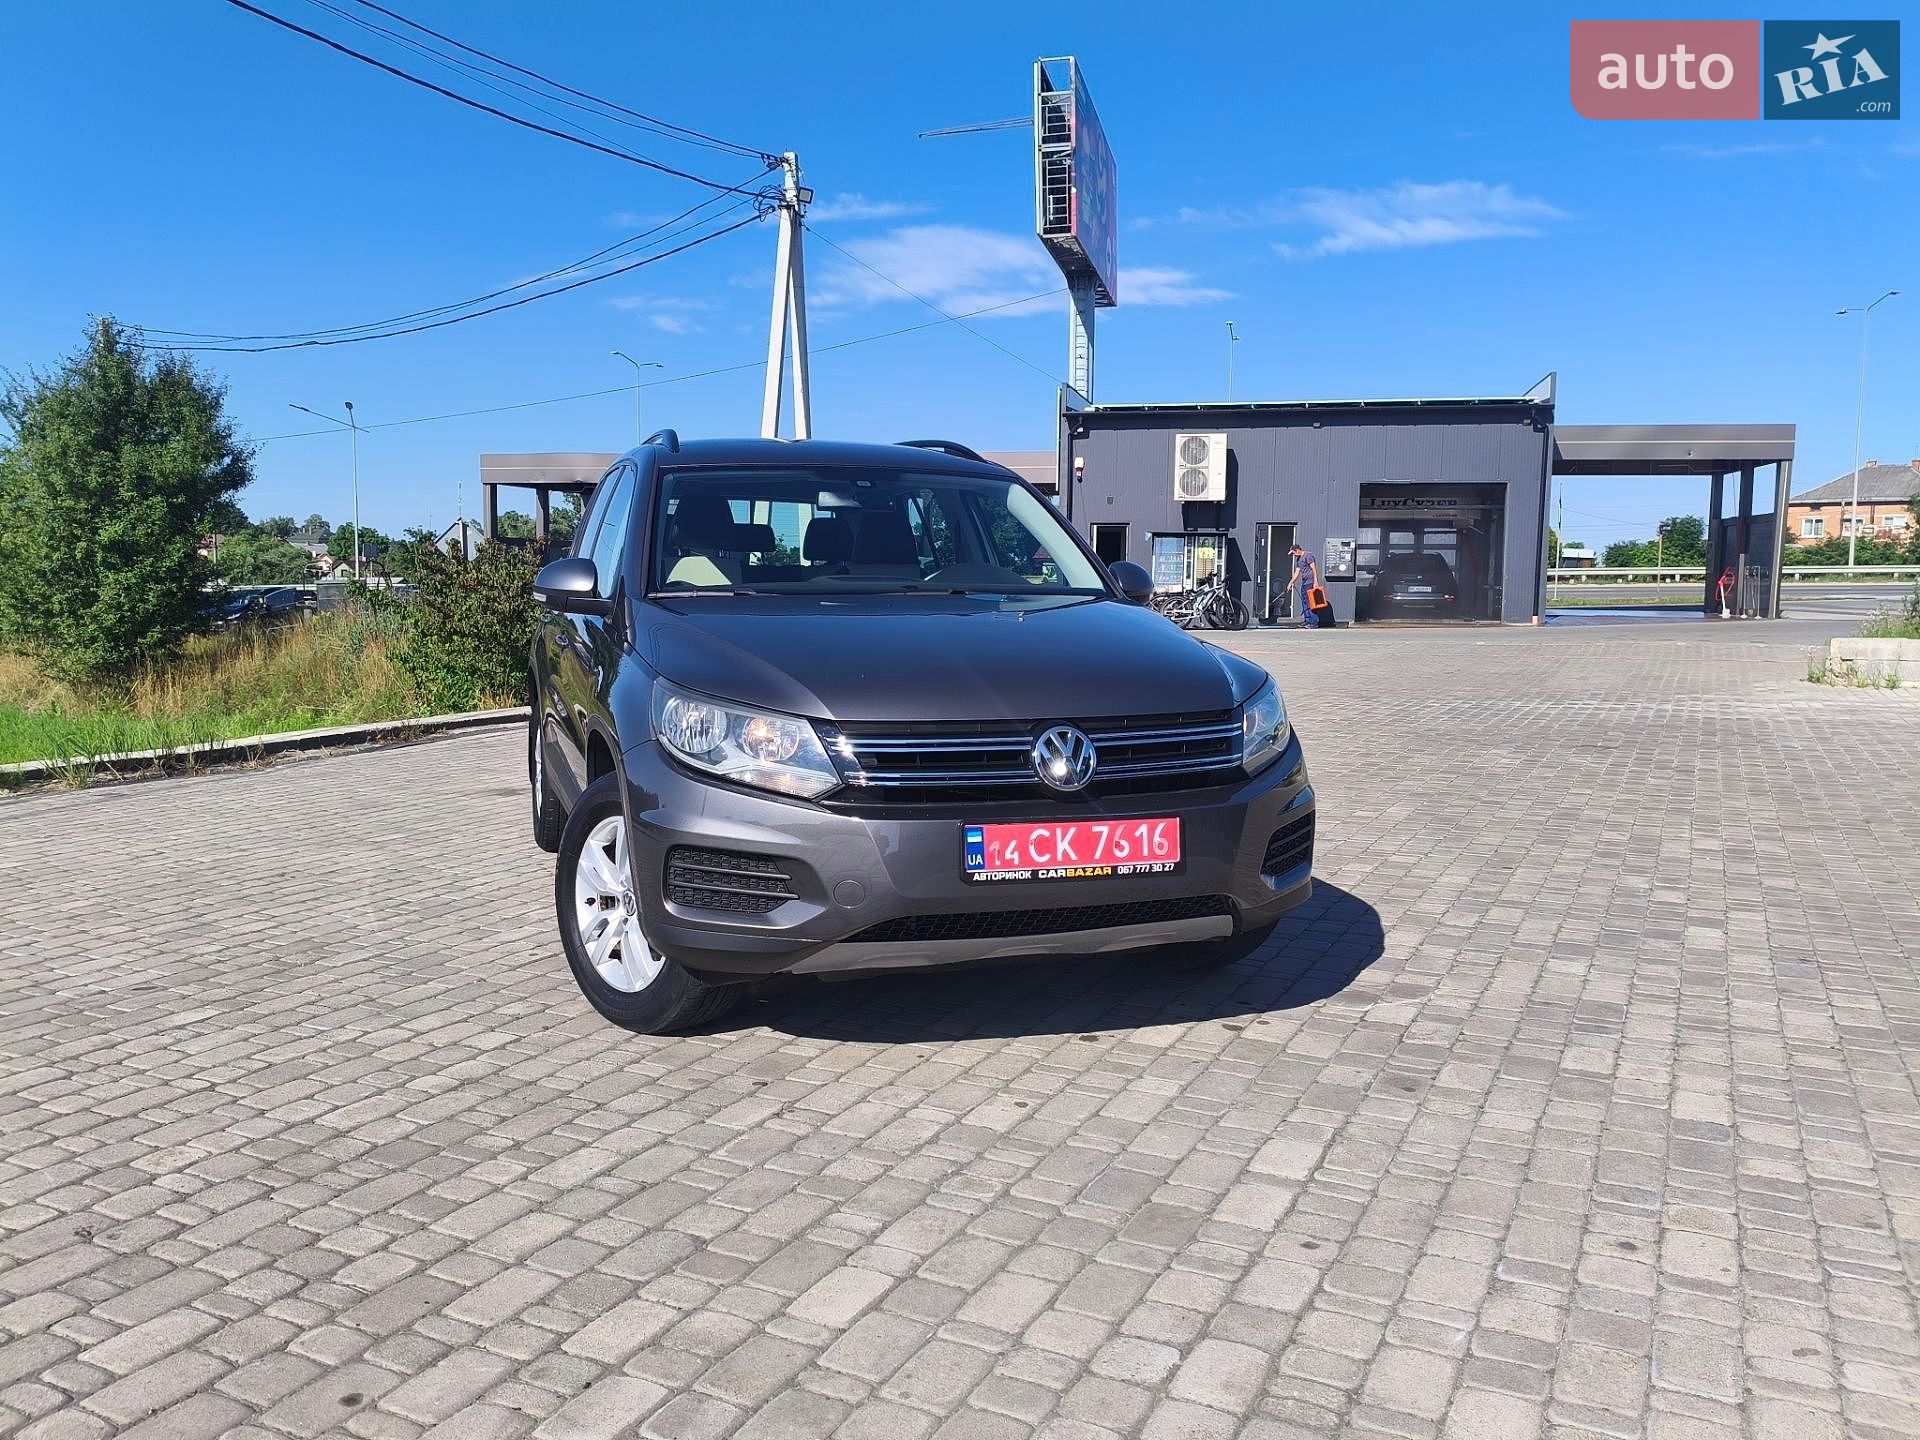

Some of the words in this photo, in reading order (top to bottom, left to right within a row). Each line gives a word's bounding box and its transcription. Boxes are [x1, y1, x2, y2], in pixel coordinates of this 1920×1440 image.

[988, 840, 1020, 866] 14
[1028, 826, 1079, 864] CK
[1091, 822, 1170, 860] 7616
[967, 854, 984, 866] UA
[1135, 864, 1150, 873] 777
[1151, 863, 1162, 872] 30
[1164, 862, 1175, 871] 27
[973, 870, 1032, 881] АВТОРИНОК
